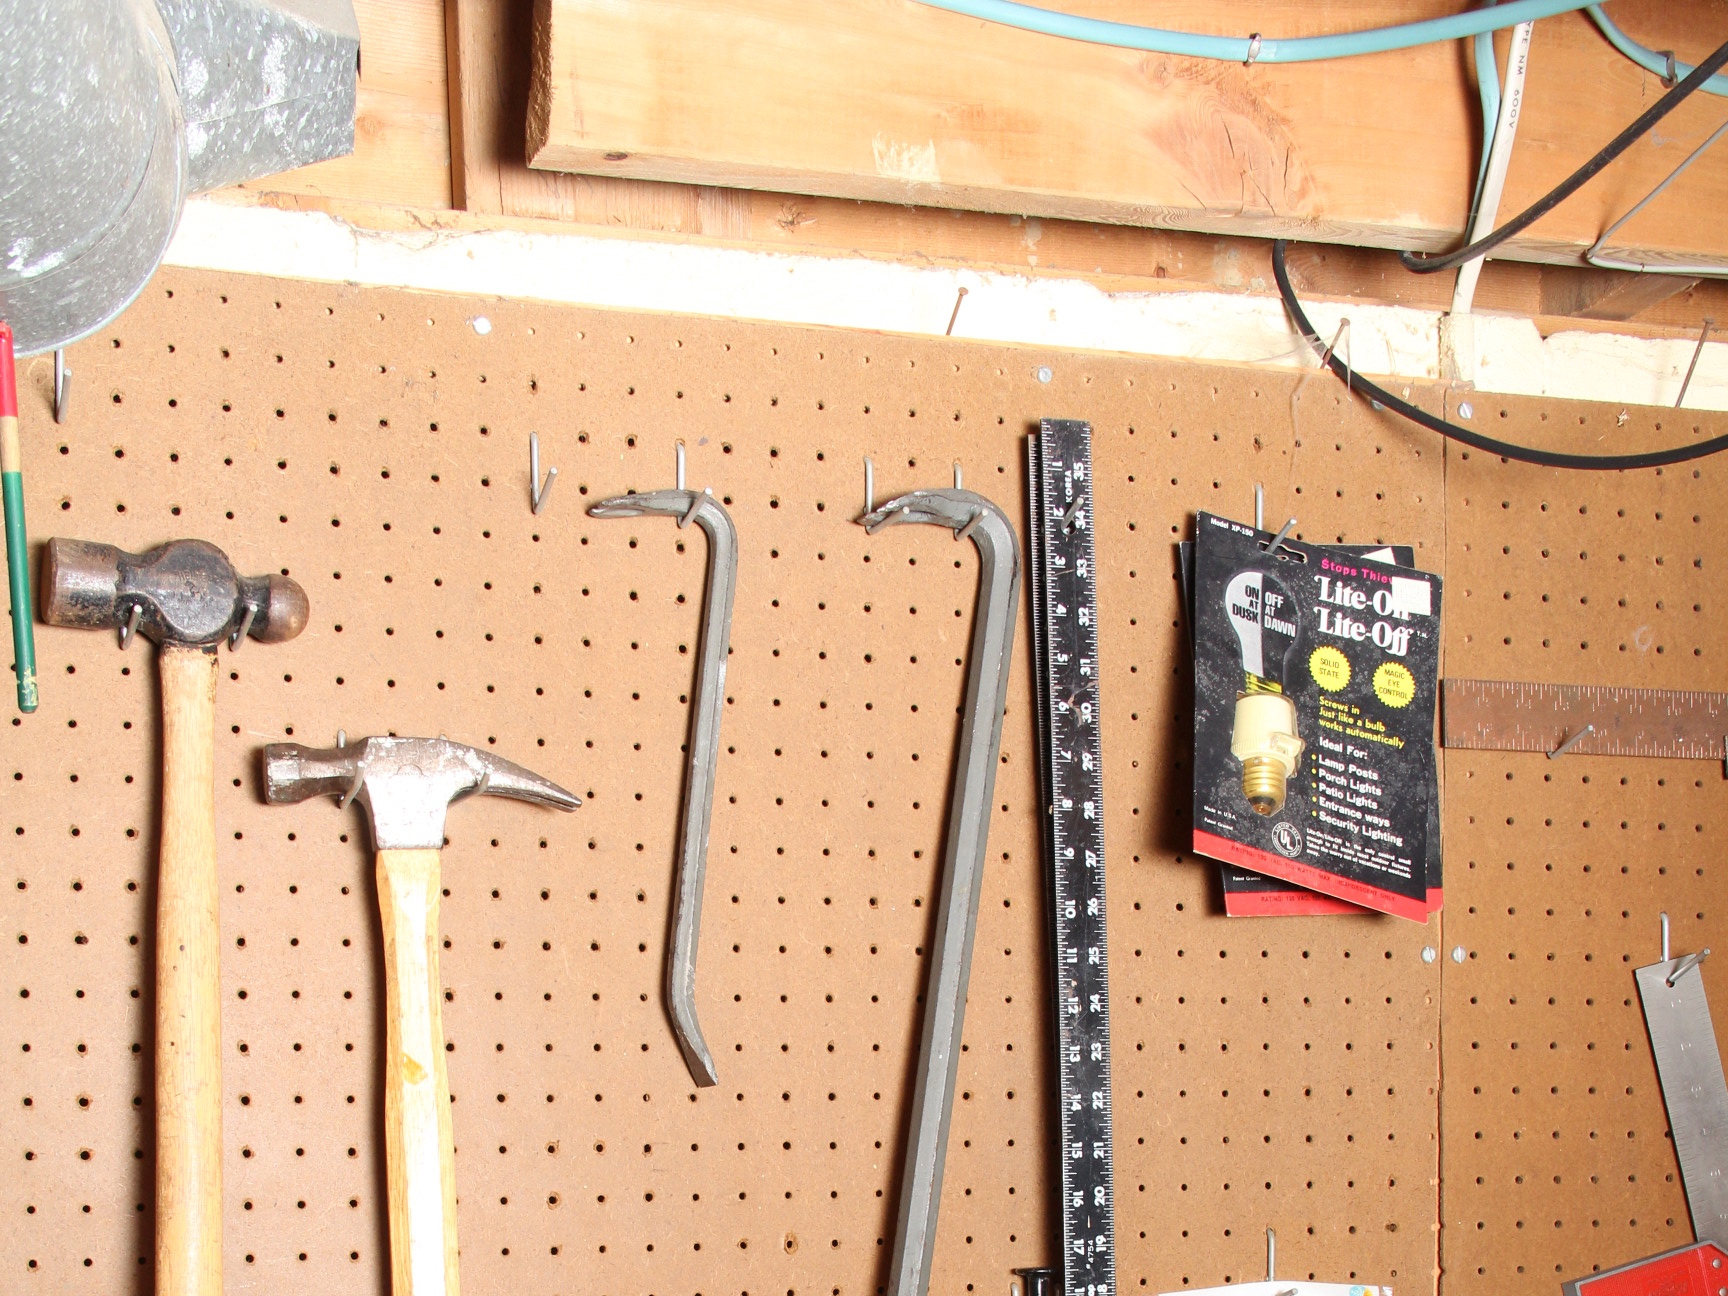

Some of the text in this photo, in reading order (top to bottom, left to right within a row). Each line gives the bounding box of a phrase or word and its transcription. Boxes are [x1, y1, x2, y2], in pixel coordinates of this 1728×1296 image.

[1517, 55, 1525, 75] NM
[1509, 89, 1520, 128] 600V
[1073, 462, 1084, 481] 35
[1065, 470, 1073, 503] KOREA
[1075, 510, 1086, 529] 34
[1210, 518, 1254, 537] Model XP-150
[1076, 559, 1087, 578] 33
[1245, 585, 1259, 600] ON
[1265, 592, 1284, 609] OFF
[1232, 603, 1259, 624] DUSK
[1249, 600, 1259, 610] AT
[1265, 607, 1276, 617] AT
[1078, 607, 1089, 626] 32
[1264, 615, 1296, 638] DAWN
[1313, 606, 1414, 656] Lite-Off
[1080, 658, 1091, 676] 31
[1321, 658, 1339, 669] SOLID
[1319, 668, 1339, 679] STATE
[1384, 669, 1405, 679] MAGIC
[1379, 687, 1407, 699] CONTROL
[1388, 679, 1400, 688] EYE
[1081, 702, 1092, 724] 30
[1319, 695, 1359, 714] Screws in
[1319, 707, 1385, 732] Just like a bulb
[1319, 719, 1405, 750] works automatically
[1320, 736, 1368, 759] Ideal For:
[1082, 752, 1093, 771] 29
[1319, 754, 1378, 780] Lamp Posts
[1319, 768, 1382, 796] Porch Lights
[1319, 782, 1378, 810] Patio Lights
[1083, 801, 1094, 820] 28
[1319, 796, 1390, 827] Entrance ways
[1319, 811, 1404, 847] Security Lighting
[1085, 850, 1096, 868] 27
[1064, 900, 1076, 919] 10
[1087, 897, 1098, 916] 26
[1066, 947, 1077, 963] 11
[1088, 946, 1100, 965] 25
[1068, 997, 1079, 1014] 12
[1090, 994, 1101, 1013] 24
[1070, 1046, 1080, 1062] 13
[1091, 1043, 1102, 1061] 23
[1070, 1094, 1082, 1111] 14
[1092, 1091, 1103, 1109] 22
[1071, 1142, 1083, 1159] 15
[1093, 1142, 1104, 1159] 21
[1072, 1190, 1084, 1208] 16
[1094, 1186, 1105, 1206] 20
[1074, 1239, 1085, 1255] 17
[1095, 1235, 1107, 1252] 19
